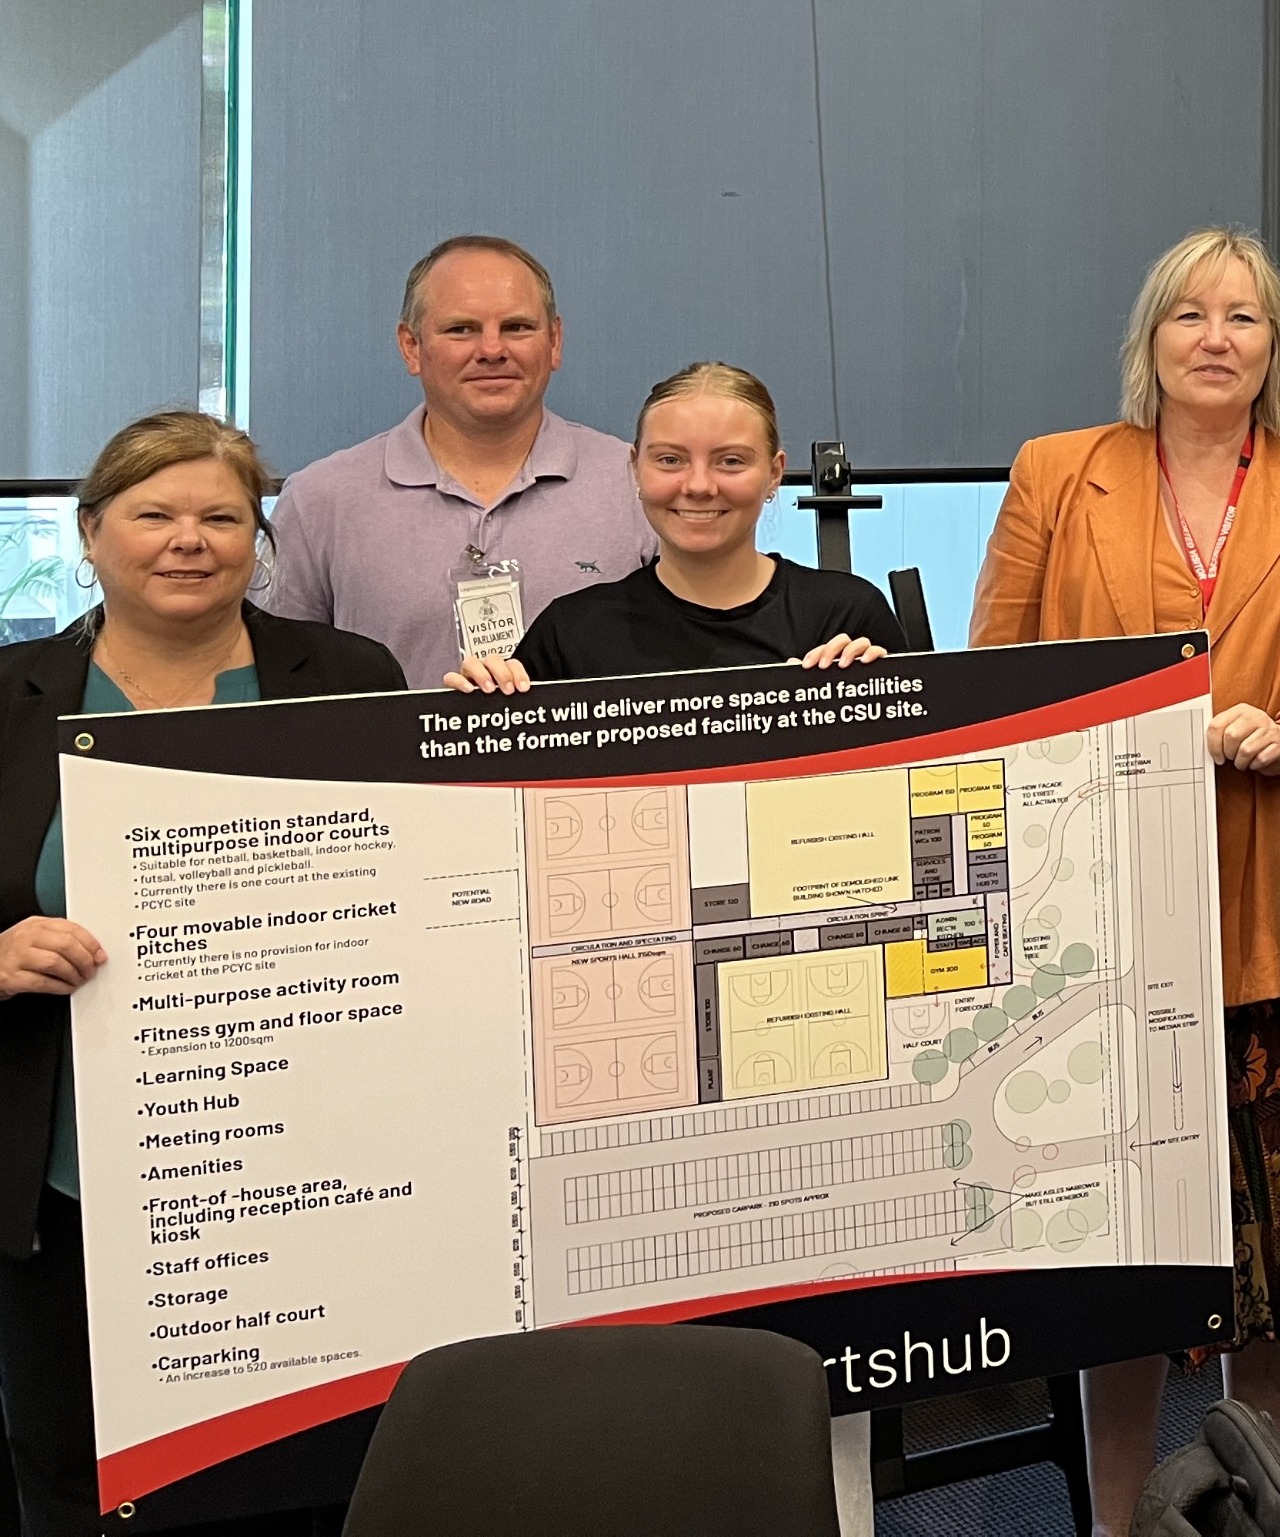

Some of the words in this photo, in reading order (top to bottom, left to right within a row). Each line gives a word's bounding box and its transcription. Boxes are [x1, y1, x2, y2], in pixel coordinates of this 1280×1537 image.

[468, 617, 514, 633] VISITOR
[473, 630, 514, 645] PARLIAMENT
[420, 715, 461, 732] The
[467, 706, 546, 733] project
[551, 703, 587, 721] will
[593, 699, 665, 718] deliver
[670, 695, 723, 712] more
[729, 690, 789, 710] space
[795, 683, 831, 701] and
[836, 678, 922, 698] facilities
[420, 741, 470, 758] than
[475, 736, 511, 753] the
[517, 730, 591, 750] former
[597, 719, 696, 747] proposed
[701, 714, 772, 734] facility
[777, 711, 797, 727] at
[802, 709, 835, 725] the
[840, 704, 880, 722] CSU
[886, 701, 927, 718] site.
[132, 827, 160, 841] Six
[166, 819, 280, 839] competition
[286, 808, 374, 828] standard,
[133, 837, 258, 858] multipurpose
[265, 830, 324, 846] indoor
[329, 823, 389, 839] courts
[140, 859, 186, 871] Suitable
[189, 857, 205, 866] for
[316, 845, 351, 854] indoor
[136, 925, 178, 940] Four
[183, 915, 262, 935] movable
[268, 910, 327, 926] indoor
[332, 901, 396, 920] cricket
[137, 938, 207, 959] pitches
[139, 988, 271, 1011] Multi-purpose
[276, 978, 346, 996] activity
[352, 973, 398, 988] room
[141, 1026, 210, 1043] Fitness
[215, 1021, 254, 1038] gym
[260, 1013, 293, 1030] and
[299, 1011, 342, 1025] floor
[348, 1004, 402, 1022] space
[143, 1065, 225, 1085] Learning
[231, 1059, 288, 1077] Space
[144, 1098, 198, 1117] Youth
[204, 1094, 239, 1110] Hub
[146, 1129, 219, 1149] Meeting
[225, 1123, 284, 1140] rooms
[148, 1160, 242, 1181] Amenities
[149, 1190, 226, 1212] Front-of
[302, 1179, 346, 1193] area,
[150, 1207, 234, 1229] including
[240, 1195, 329, 1217] reception
[334, 1187, 373, 1204] café
[379, 1181, 411, 1199] and
[151, 1226, 200, 1244] kiosk
[153, 1257, 199, 1275] Staff
[205, 1252, 268, 1269] offices
[155, 1289, 227, 1307] Storage
[156, 1320, 231, 1339] Outdoor
[236, 1311, 270, 1329] half
[276, 1305, 325, 1323] court
[158, 1348, 259, 1370] Carparking
[166, 1374, 180, 1383] An
[183, 1368, 230, 1380] increase
[233, 1366, 244, 1374] to
[247, 1361, 267, 1372] 520
[270, 1355, 317, 1369] available
